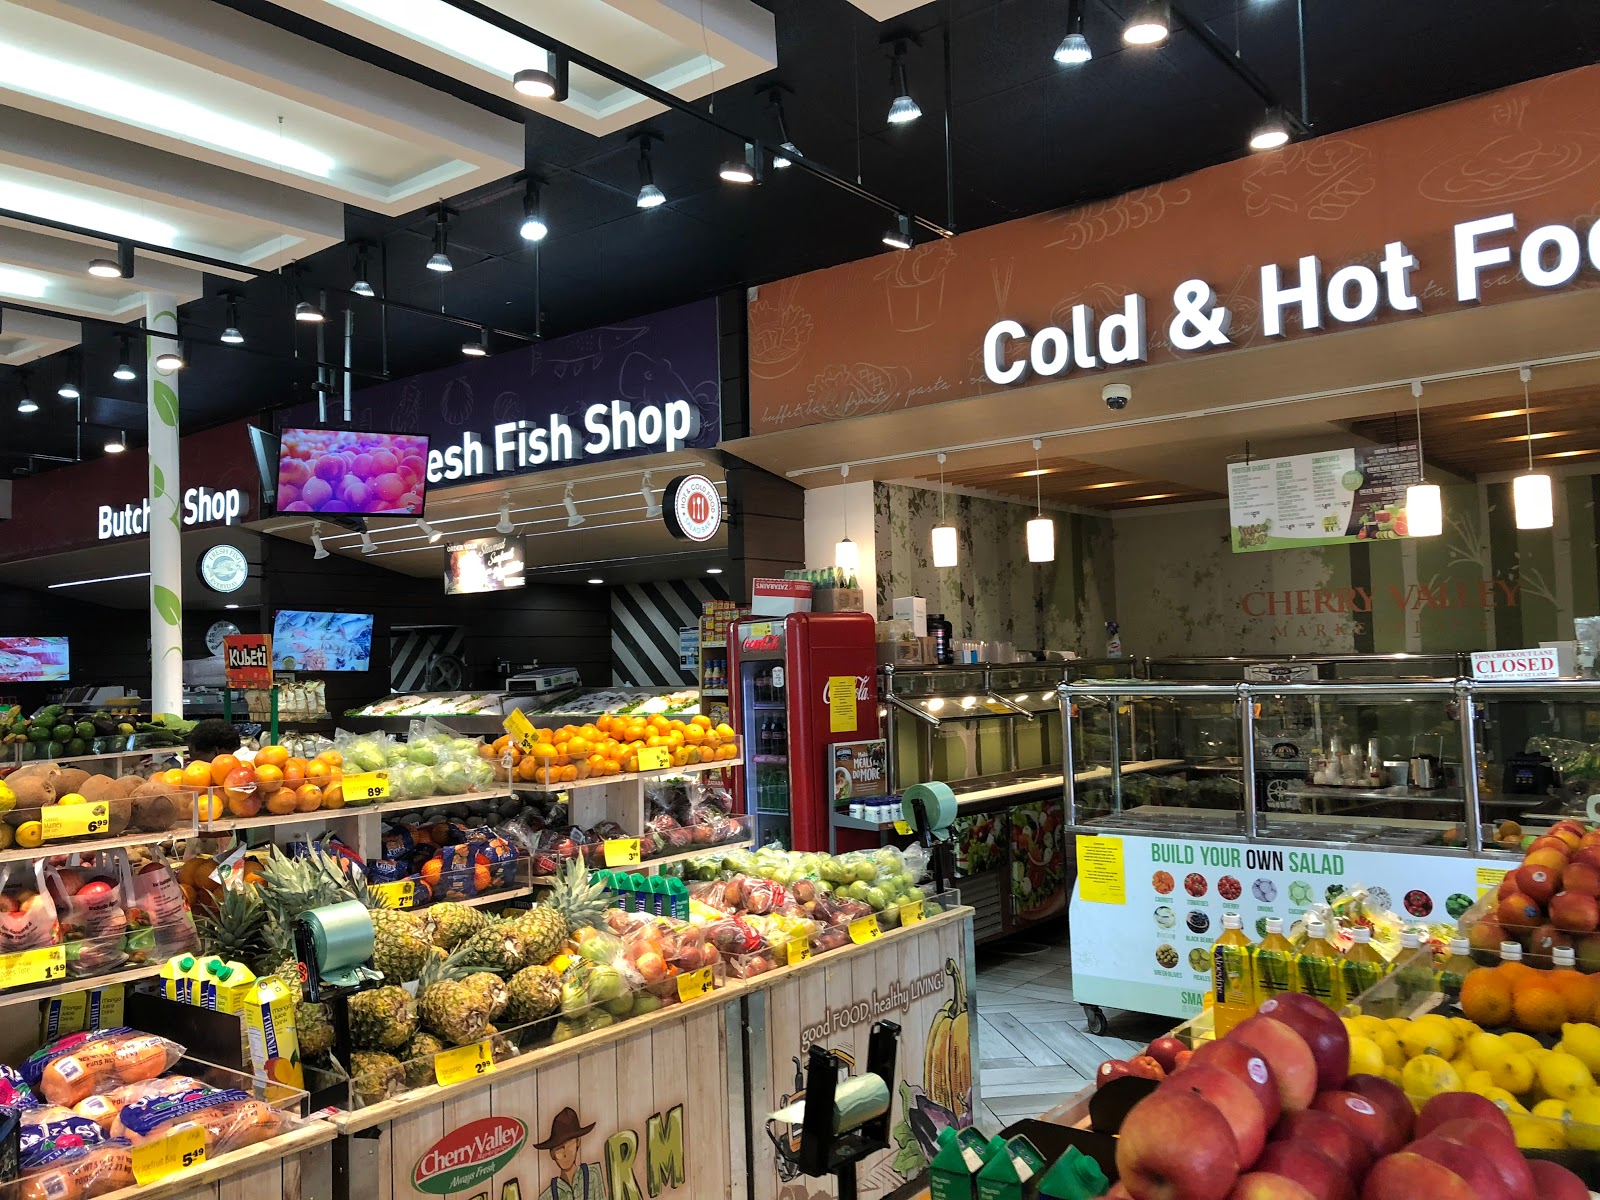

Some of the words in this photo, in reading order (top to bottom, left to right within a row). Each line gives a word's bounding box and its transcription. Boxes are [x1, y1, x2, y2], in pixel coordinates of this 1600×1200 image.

[983, 293, 1142, 385] Cold
[1169, 278, 1231, 351] &
[1260, 240, 1419, 337] Hot
[1454, 212, 1600, 303] Fo
[761, 404, 802, 424] buffet
[904, 376, 952, 407] pasta
[427, 431, 485, 483] esh
[494, 413, 573, 472] Fish
[584, 399, 692, 453] Shop
[691, 483, 706, 493] COLD
[706, 491, 716, 514] FOOD
[98, 498, 151, 540] Butch
[184, 486, 240, 525] Shop
[684, 517, 701, 534] SALAD
[702, 520, 712, 533] BAR
[209, 549, 229, 561] FRESH
[230, 549, 243, 565] FISH
[210, 578, 239, 590] EVERYDAY
[1241, 586, 1376, 618] CHERRY
[1389, 580, 1521, 611] VALLEY
[1492, 651, 1532, 659] CHECKOUT
[1476, 657, 1554, 674] CLOSED
[853, 757, 873, 769] MEALS
[860, 768, 881, 782] MORE
[1151, 843, 1194, 865] BUILD
[1200, 846, 1241, 868] YOUR
[1246, 849, 1284, 872] OWN
[1289, 851, 1345, 876] SALAD
[1155, 896, 1174, 904] CARROTS
[1187, 899, 1209, 907] TOMATOES
[1168, 970, 1183, 979] OLIVES
[1193, 974, 1211, 982] PICKLES
[1181, 991, 1203, 1006] SMA
[272, 1004, 291, 1014] Mango
[274, 1012, 287, 1020] Juice
[801, 1010, 830, 1053] good
[832, 1003, 872, 1035] FOOD,
[872, 983, 910, 1015] healthy
[910, 972, 944, 1000] LIVING!
[275, 1018, 288, 1026] Drink
[263, 1012, 277, 1056] PINEHILL
[421, 1142, 476, 1176] Cherry
[474, 1125, 519, 1155] Valley
[449, 1170, 475, 1190] Always
[475, 1161, 496, 1179] Fresh
